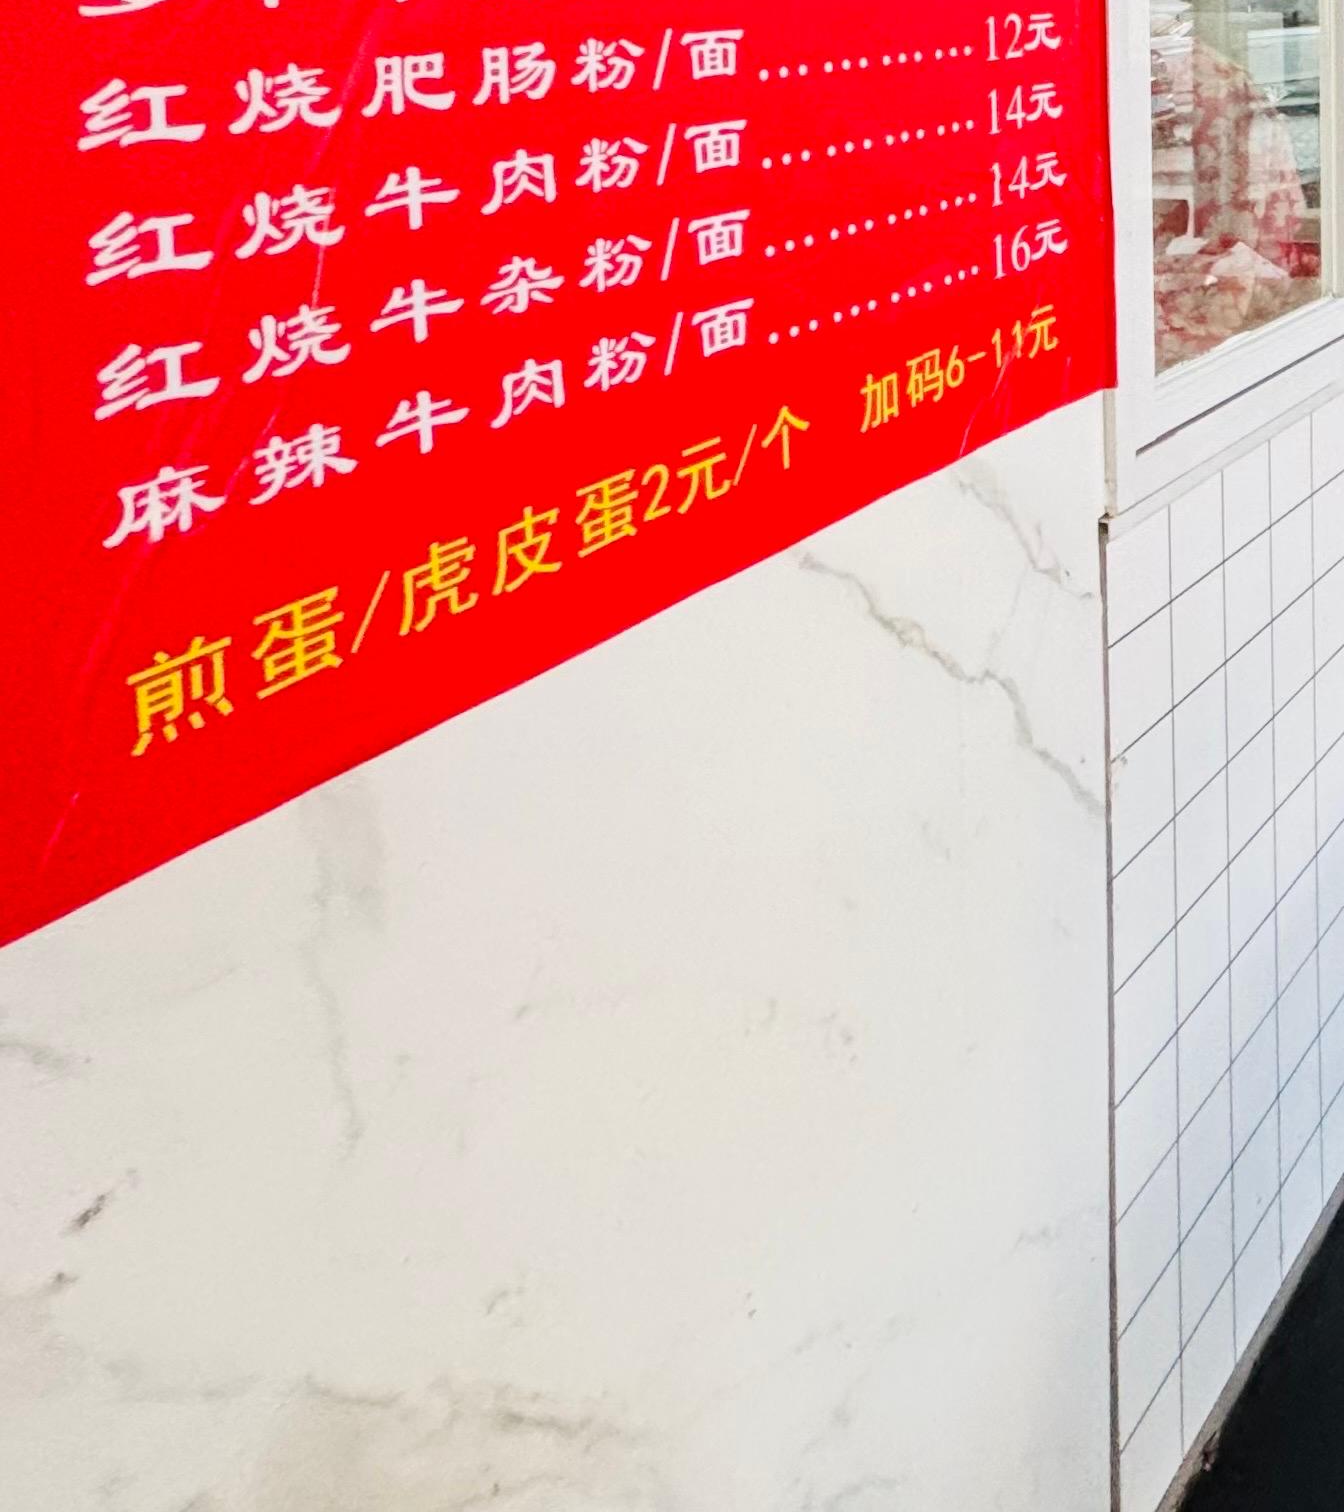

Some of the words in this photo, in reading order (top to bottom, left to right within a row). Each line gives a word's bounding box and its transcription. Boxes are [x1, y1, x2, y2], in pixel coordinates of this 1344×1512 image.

[77, 25, 744, 152] 红烧肥肠粉/面
[984, 11, 1061, 63] 12元
[86, 117, 745, 286] 红烧牛肉粉/面
[987, 80, 1063, 133] 14元
[93, 209, 751, 421] 红烧牛杂粉/面
[989, 150, 1066, 205] 14元
[103, 298, 754, 549] 麻辣牛肉粉/面
[990, 218, 1068, 279] 16元
[128, 405, 809, 757] 煎蛋/虎皮蛋2元/个
[860, 304, 1060, 434] 加码6-11元
